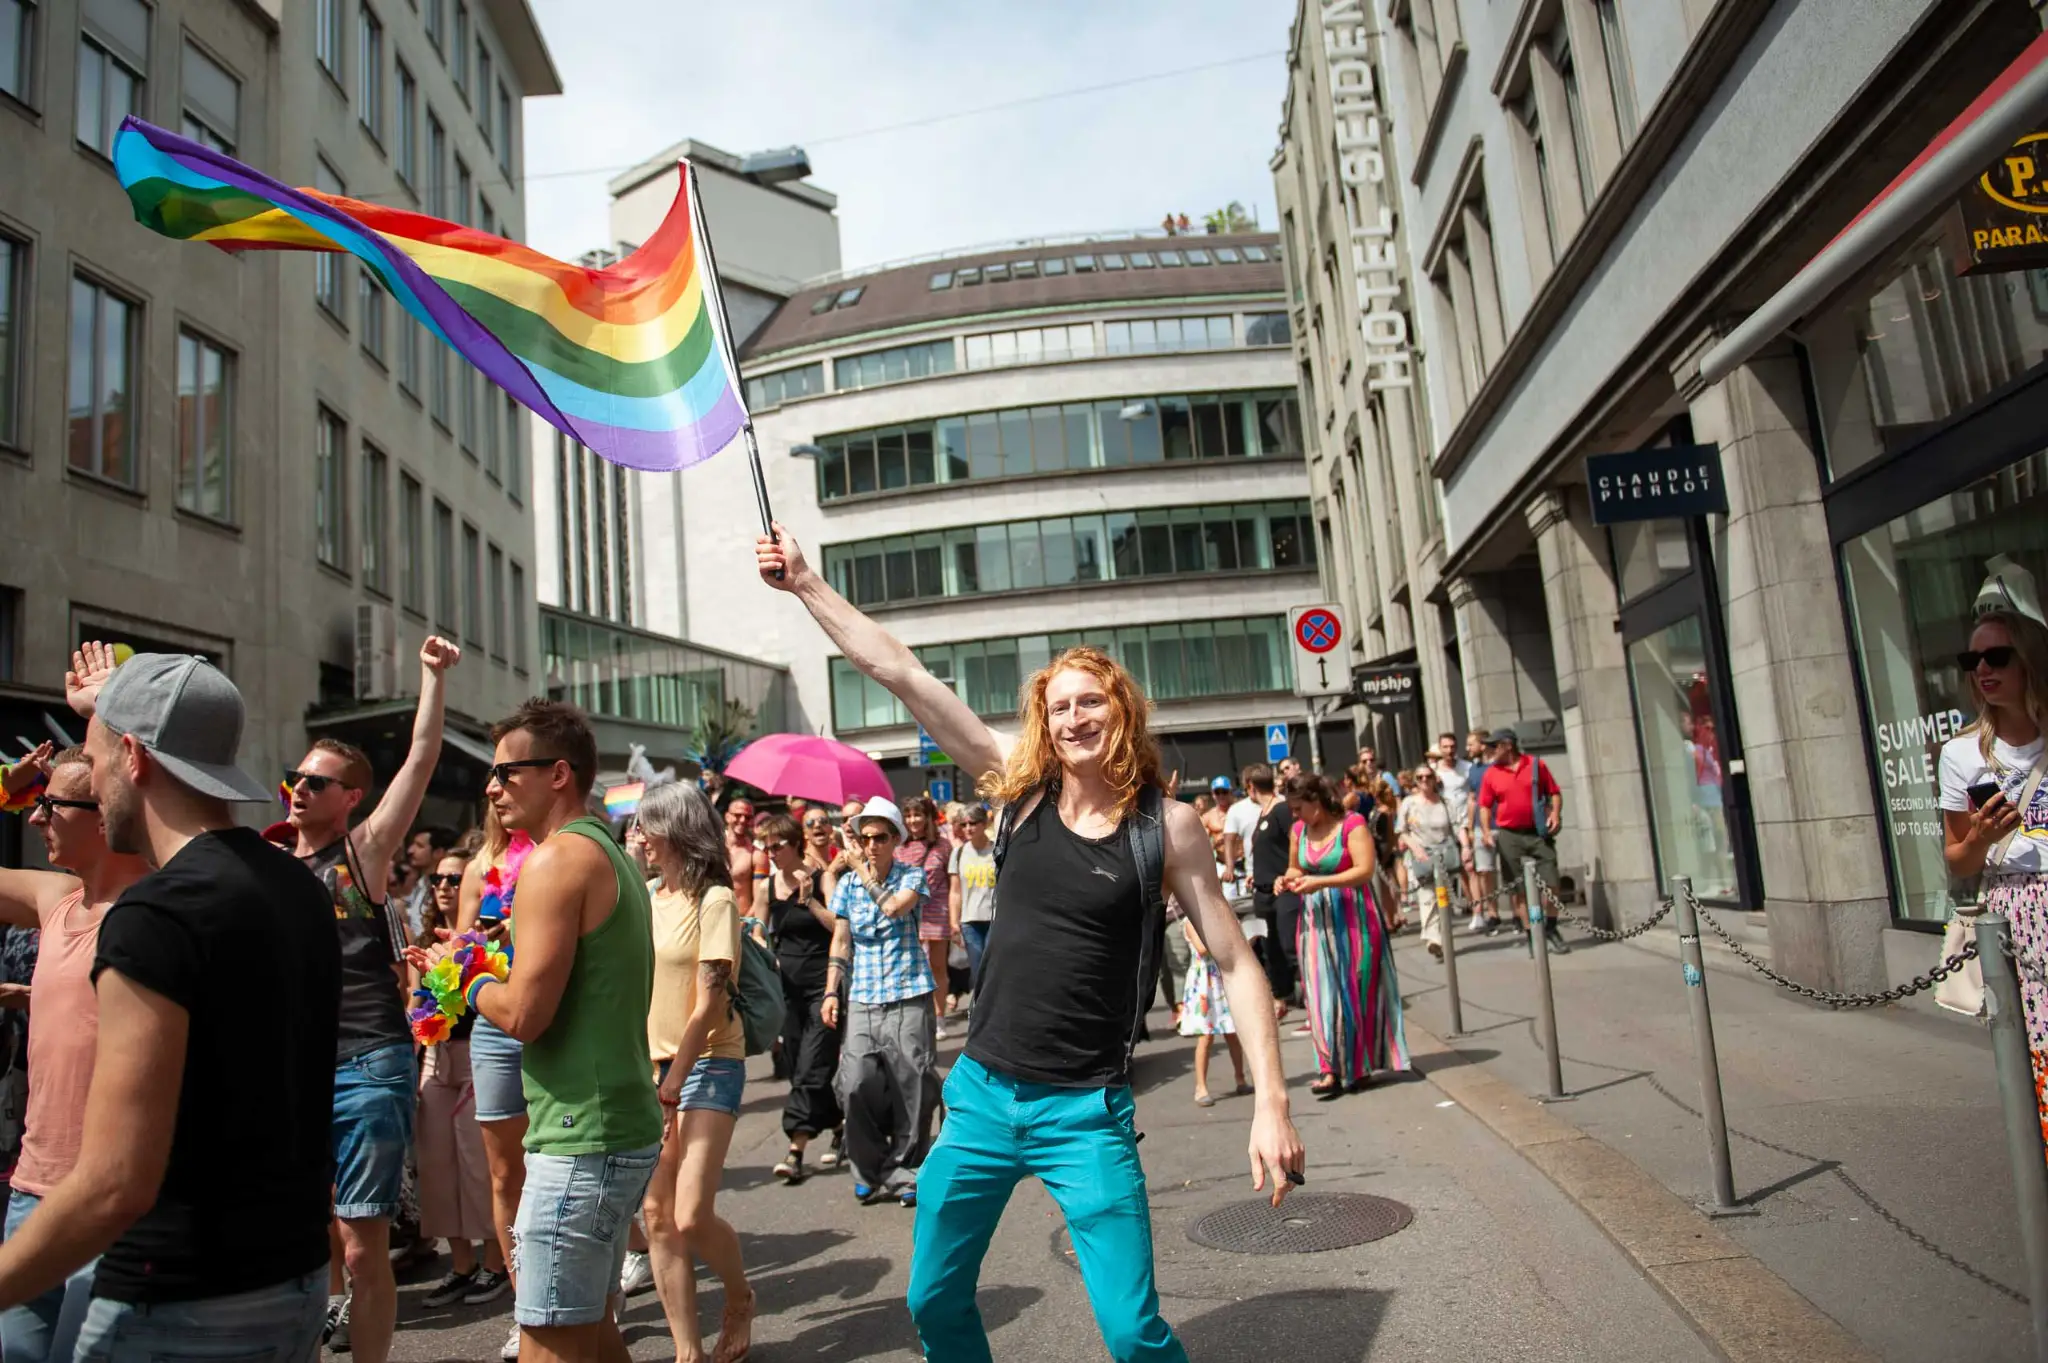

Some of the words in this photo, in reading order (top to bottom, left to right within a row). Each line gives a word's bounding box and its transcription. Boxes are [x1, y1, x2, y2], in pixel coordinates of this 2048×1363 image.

[1352, 206, 1414, 391] HOTEL
[1598, 465, 1708, 489] CLAUDIE
[1600, 479, 1710, 502] PIERLOT
[1878, 708, 1963, 753] SUMMER
[1884, 753, 1936, 788] SALE
[1891, 796, 1924, 811] SECOND
[1894, 821, 1907, 836] UP
[1908, 821, 1922, 836] TO
[1922, 821, 1943, 836] 60%
